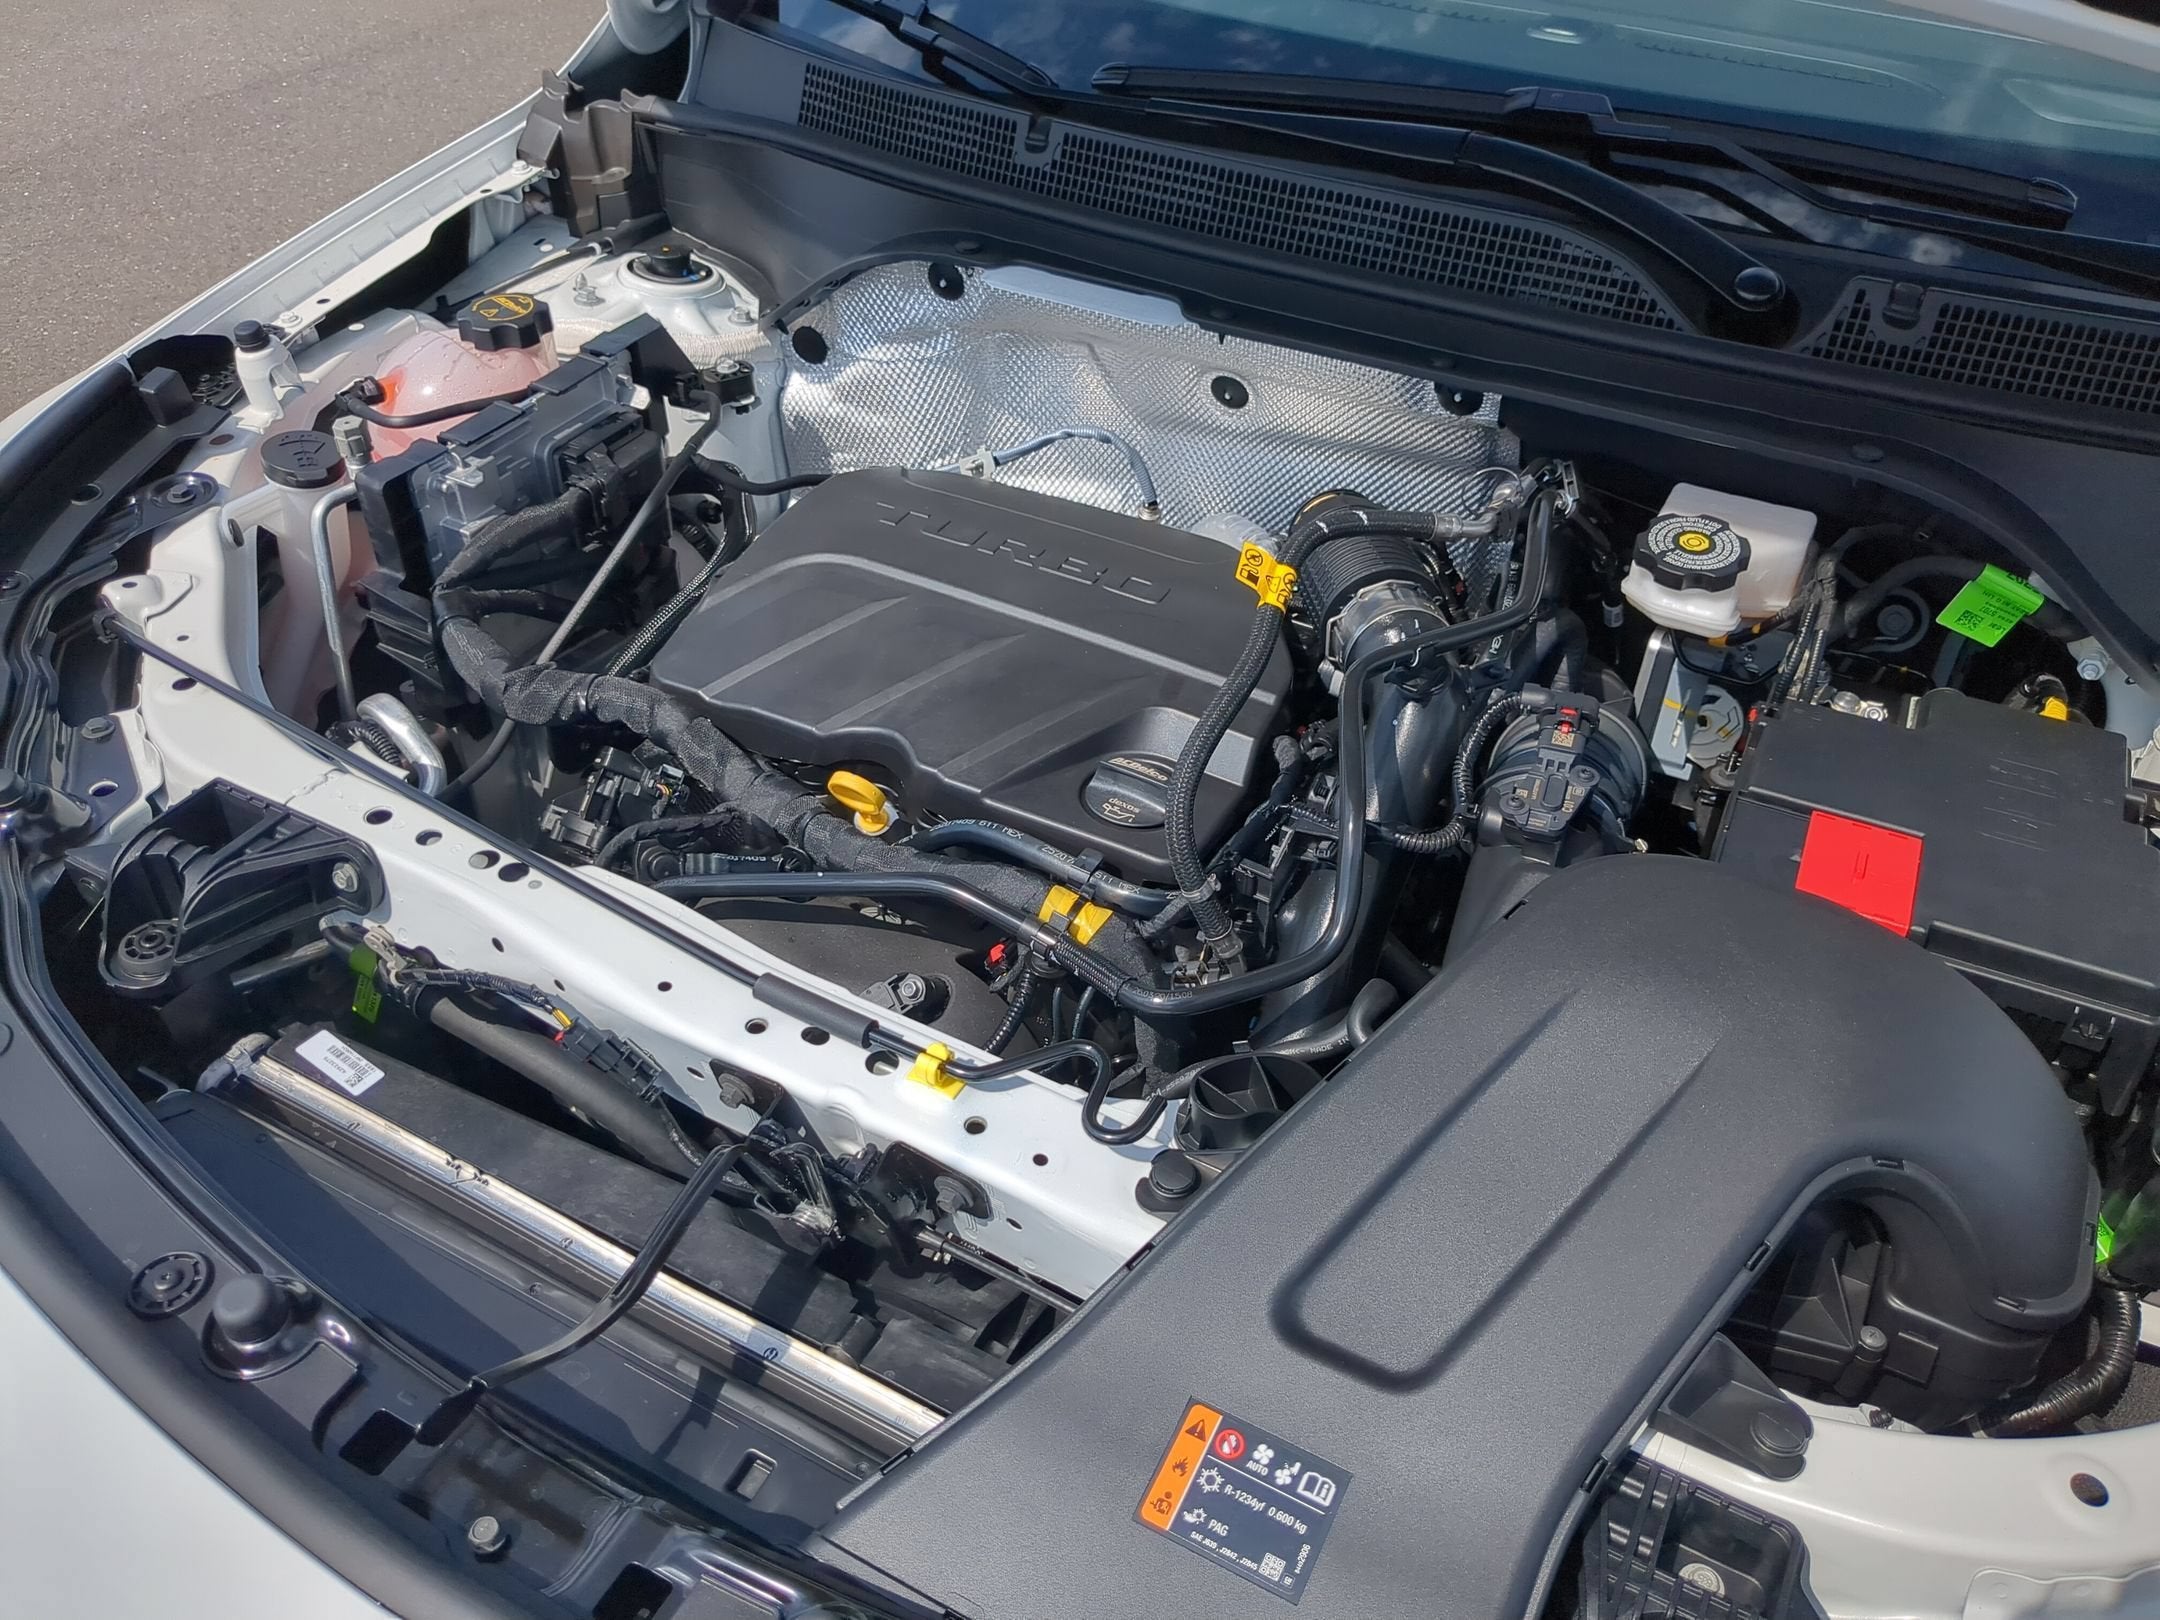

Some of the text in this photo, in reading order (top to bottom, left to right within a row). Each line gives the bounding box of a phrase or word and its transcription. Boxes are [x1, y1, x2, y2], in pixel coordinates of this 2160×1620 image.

[876, 501, 1172, 606] TURBO
[1108, 757, 1168, 781] ACDelco
[1109, 797, 1141, 814] dexos
[1002, 826, 1025, 840] MEX
[1246, 1460, 1269, 1476] AUTO
[1224, 1484, 1308, 1535] R-1234yf 0.600 kg
[1190, 1530, 1204, 1542] SAE
[1208, 1519, 1229, 1537] PAG
